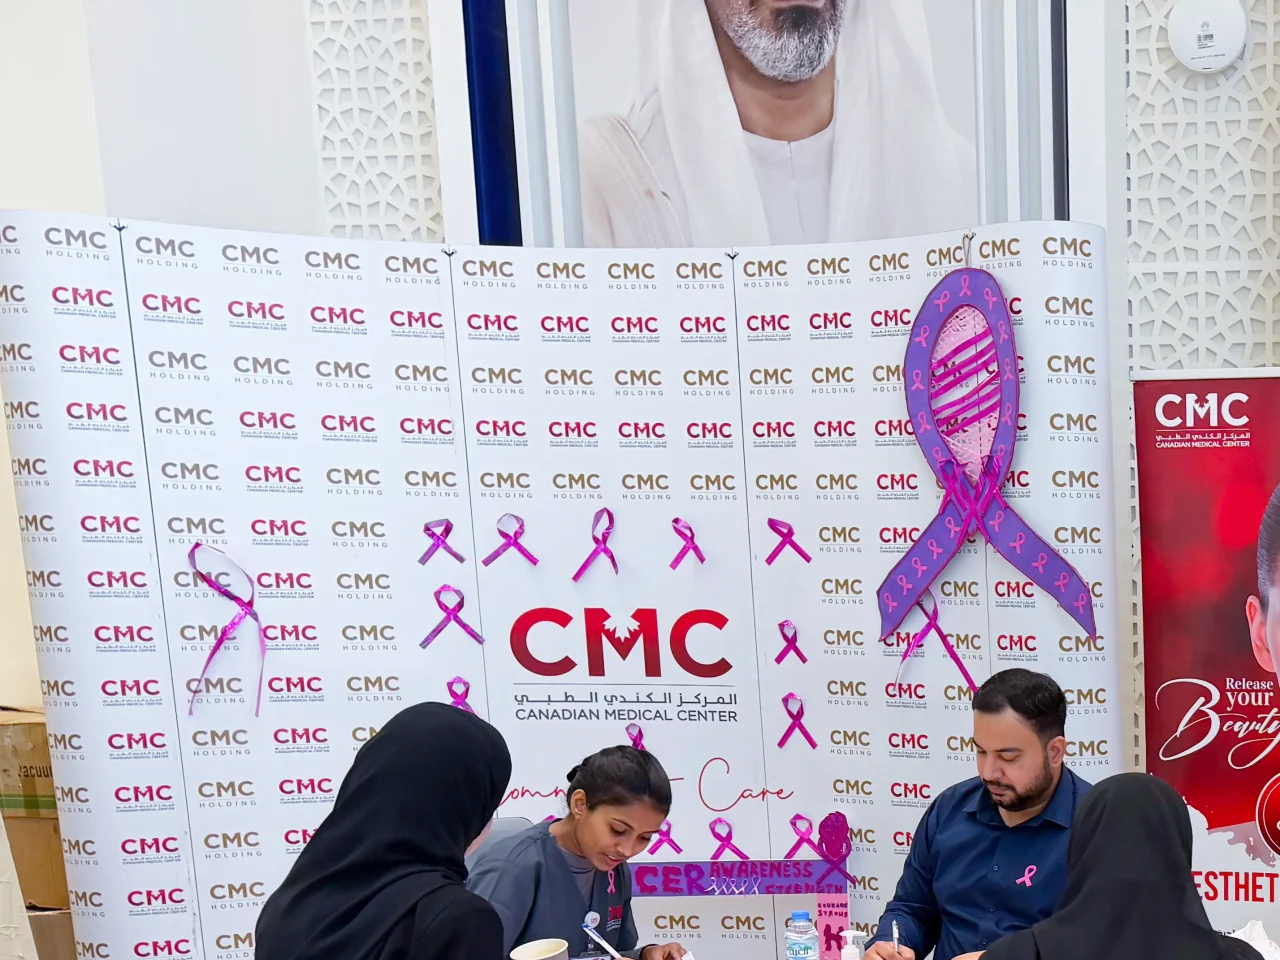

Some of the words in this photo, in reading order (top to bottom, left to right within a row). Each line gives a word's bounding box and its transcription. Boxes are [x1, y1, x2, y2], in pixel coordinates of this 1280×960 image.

[135, 236, 195, 259] CMC
[1043, 236, 1091, 259] CMC
[137, 259, 198, 269] HOLDING
[806, 258, 851, 277] CMC
[1045, 258, 1094, 269] HOLDING
[807, 277, 853, 287] HOLDING
[310, 306, 365, 326] CMC
[1155, 393, 1249, 427] CMC
[510, 607, 732, 678] CMC
[1226, 678, 1273, 690] Release
[514, 692, 598, 706] الطبي
[604, 692, 672, 706] الكندي
[677, 692, 737, 708] المركز
[1226, 691, 1273, 711] your
[516, 709, 600, 720] CANADIAN
[604, 710, 672, 721] MEDICAL
[677, 710, 738, 722] CENTER
[107, 733, 167, 750] CMC
[192, 729, 249, 747] CMC
[830, 730, 871, 748] CMC
[193, 748, 251, 757] HOLDING
[699, 758, 793, 812] Care
[709, 861, 813, 878] AWARENESS
[635, 863, 705, 895] CER
[654, 915, 700, 930] CMC
